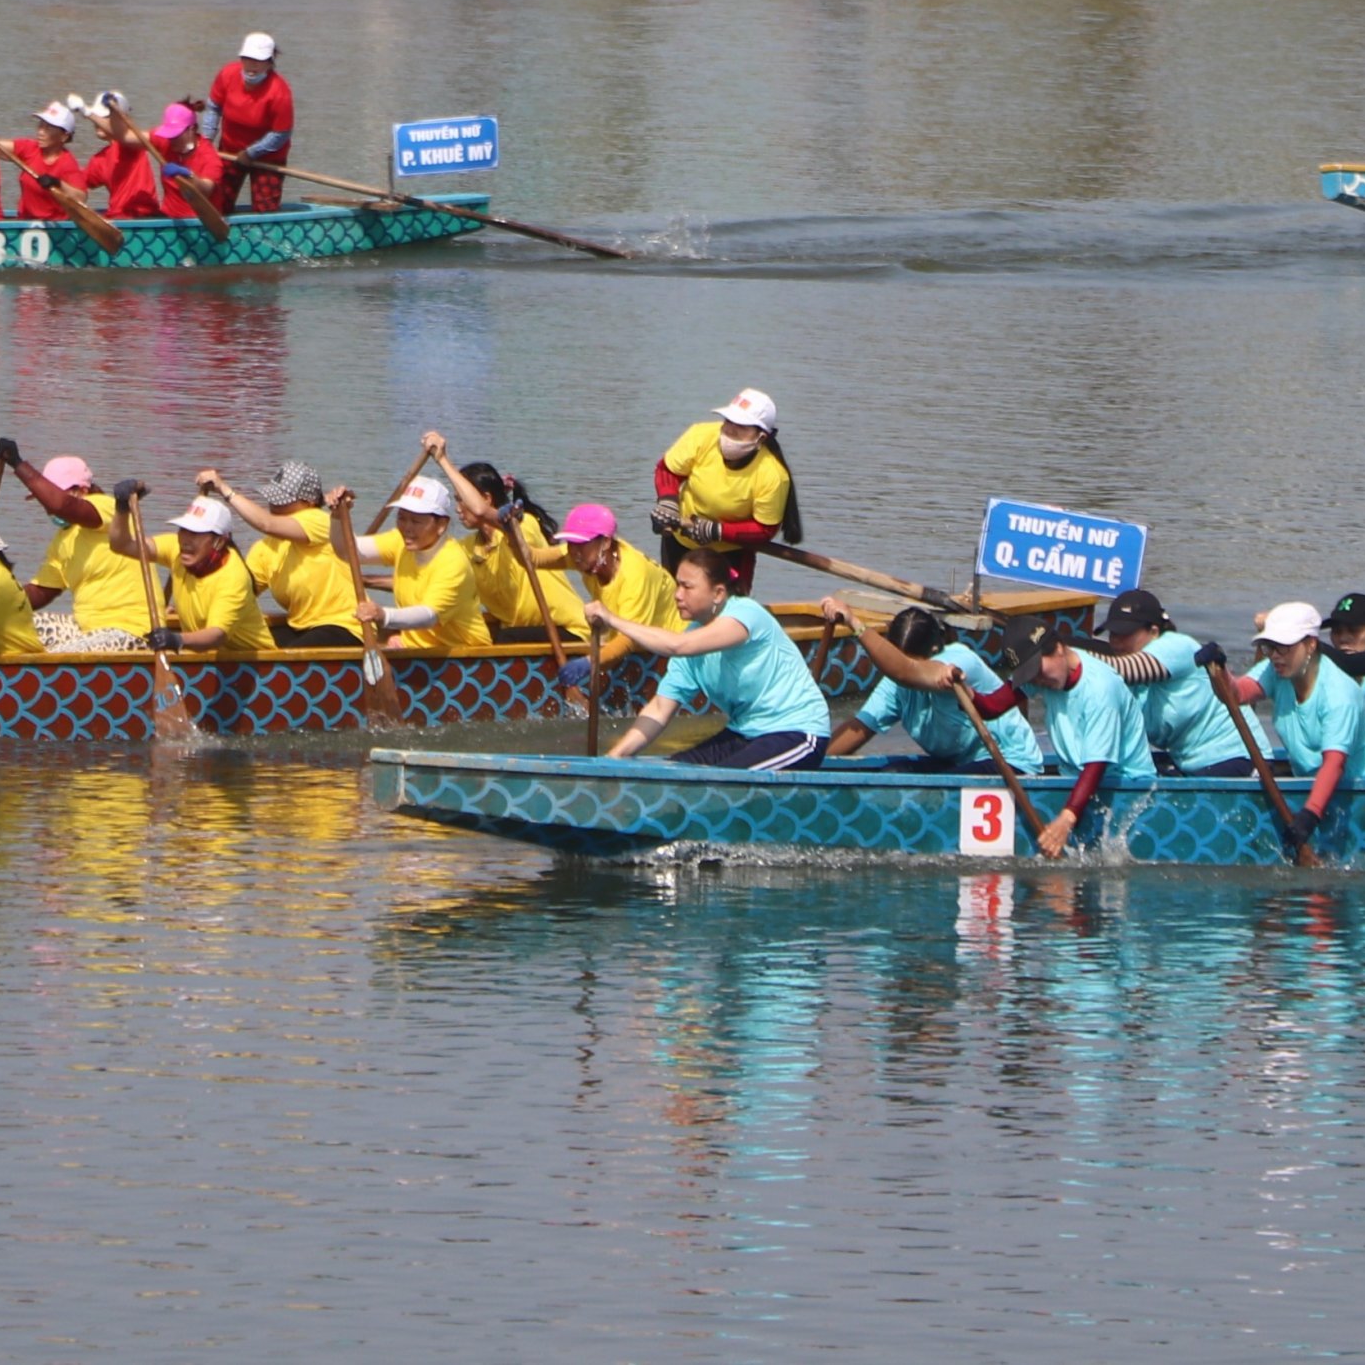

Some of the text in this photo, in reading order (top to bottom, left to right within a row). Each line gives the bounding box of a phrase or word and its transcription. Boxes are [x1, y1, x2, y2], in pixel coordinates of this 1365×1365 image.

[401, 141, 494, 167] P. KHUÊ MỸ
[1087, 527, 1120, 549] NỮ
[994, 540, 1124, 590] Q. CẨM LỆ
[972, 793, 1003, 843] 3
